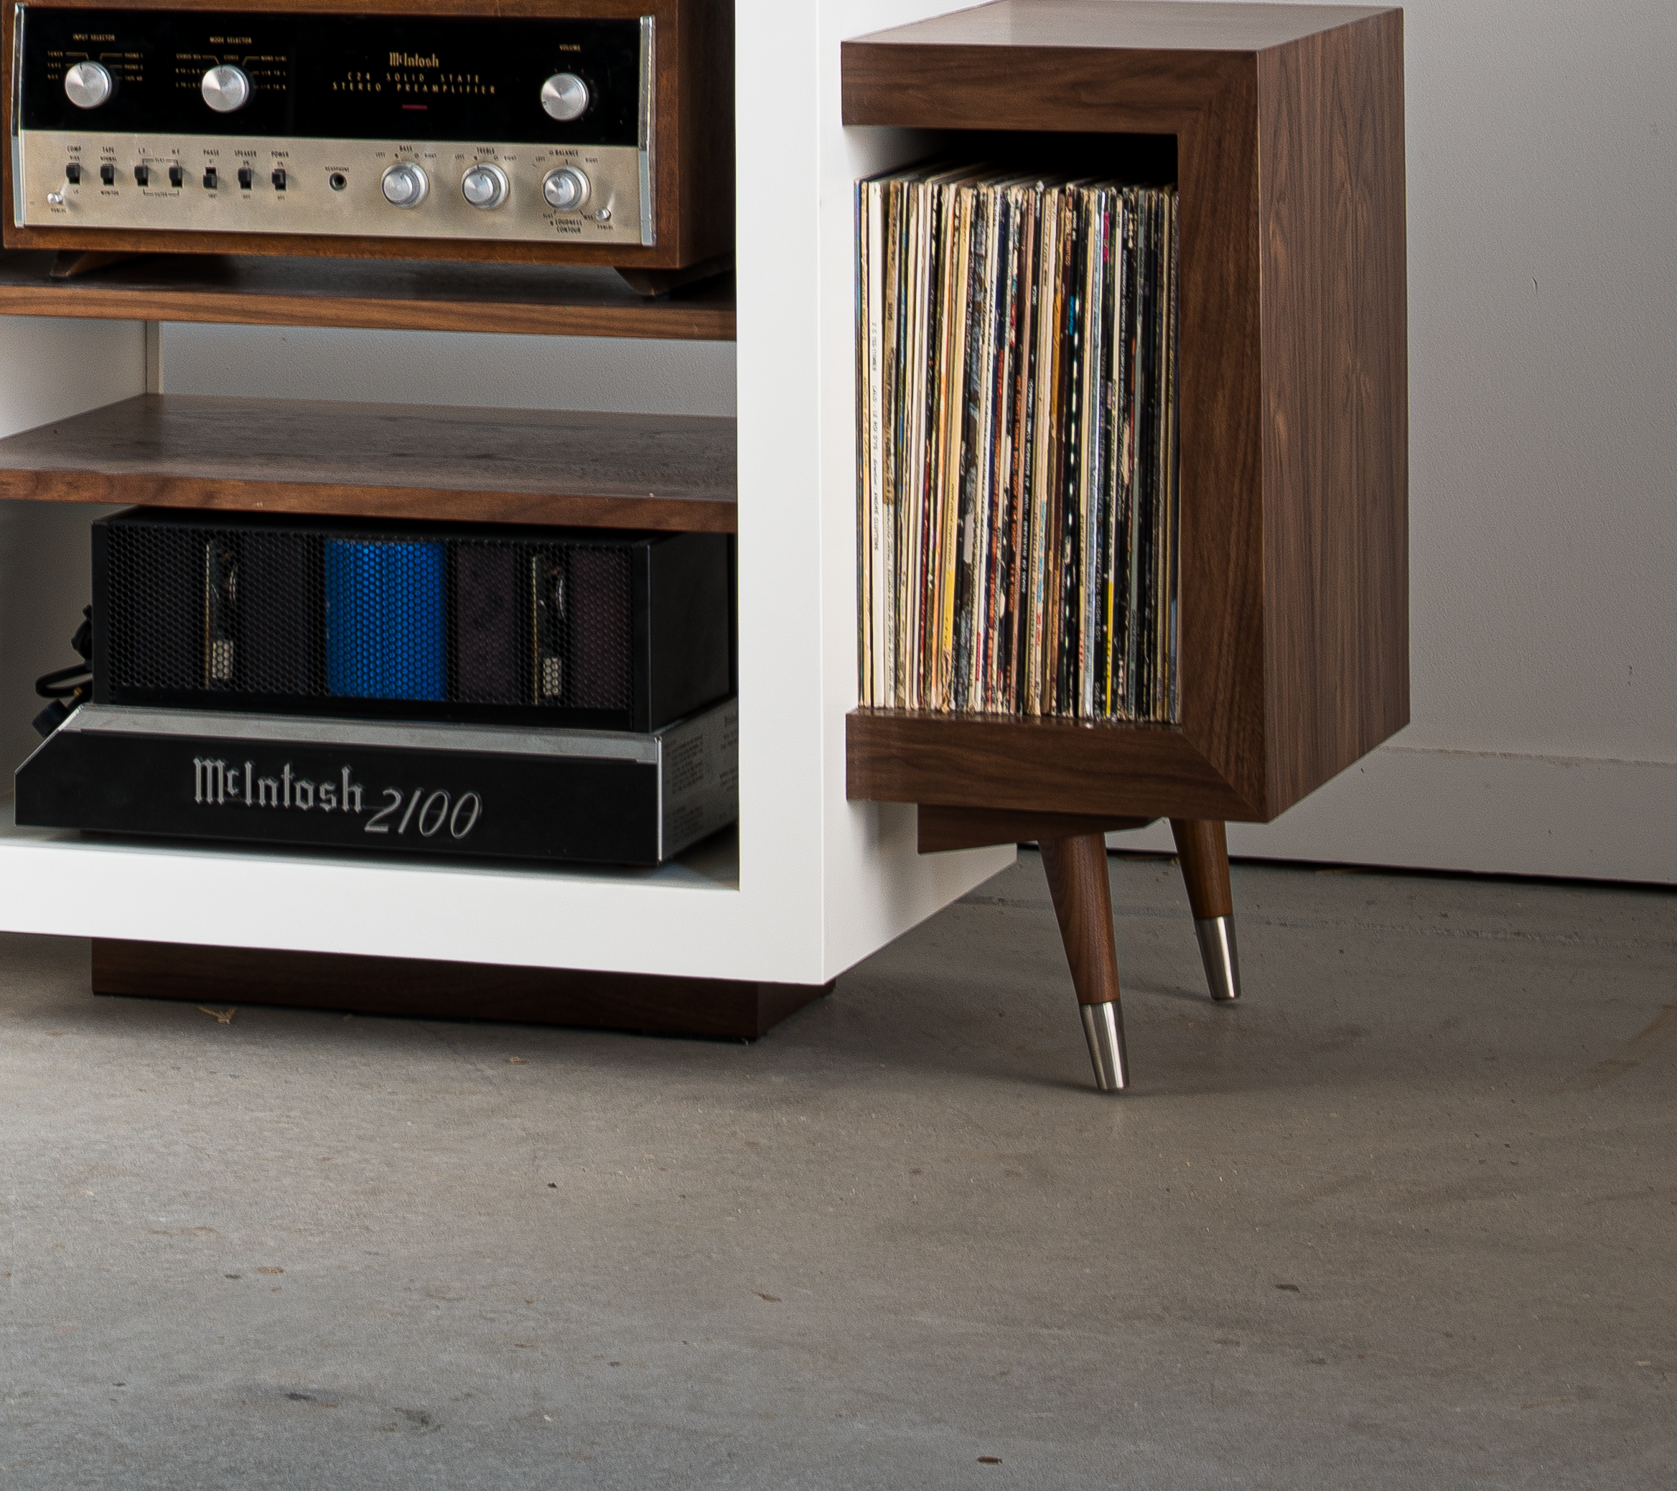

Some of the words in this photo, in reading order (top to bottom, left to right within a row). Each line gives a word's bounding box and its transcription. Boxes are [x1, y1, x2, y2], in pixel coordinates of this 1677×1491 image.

[90, 34, 115, 42] SELECTOR
[226, 37, 252, 45] SELECTOR
[559, 44, 580, 52] VOLUME
[389, 52, 439, 68] McIntosh
[348, 72, 370, 81] C24
[386, 72, 424, 83] SOLID
[440, 73, 479, 84] STATE
[333, 81, 381, 92] STEREO
[397, 83, 495, 95] PREAMPLIFIER
[102, 146, 115, 154] TAPE
[203, 149, 220, 157] PHASE
[234, 150, 257, 158] SPEAKER
[271, 150, 289, 158] POWER
[193, 757, 364, 814] McIntosh
[363, 786, 482, 839] 2100
